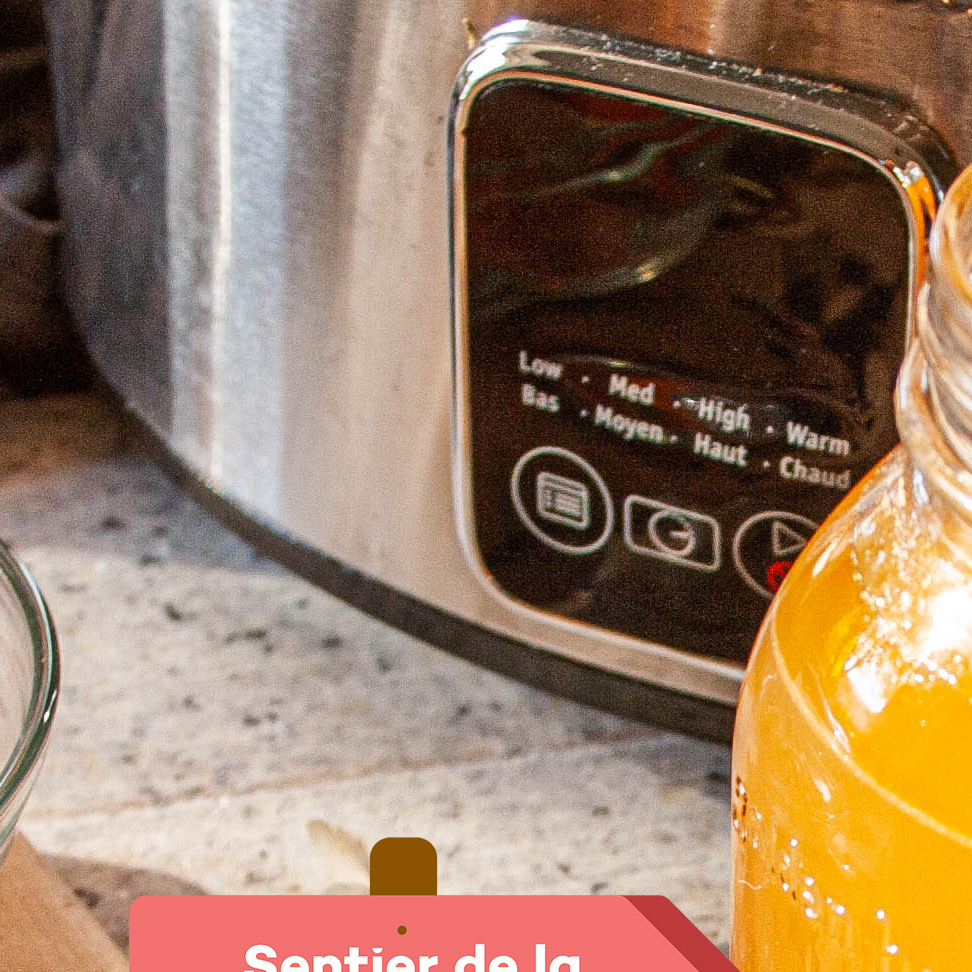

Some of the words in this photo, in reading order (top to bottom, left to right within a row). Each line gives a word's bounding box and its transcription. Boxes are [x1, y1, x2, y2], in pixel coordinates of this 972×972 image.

[519, 350, 563, 380] Low
[609, 374, 656, 405] Med
[698, 397, 750, 434] High
[786, 421, 851, 456] Warm
[521, 383, 560, 412] Bas
[595, 404, 665, 445] Moyen
[694, 433, 748, 467] Haut
[779, 456, 851, 489] Chaud
